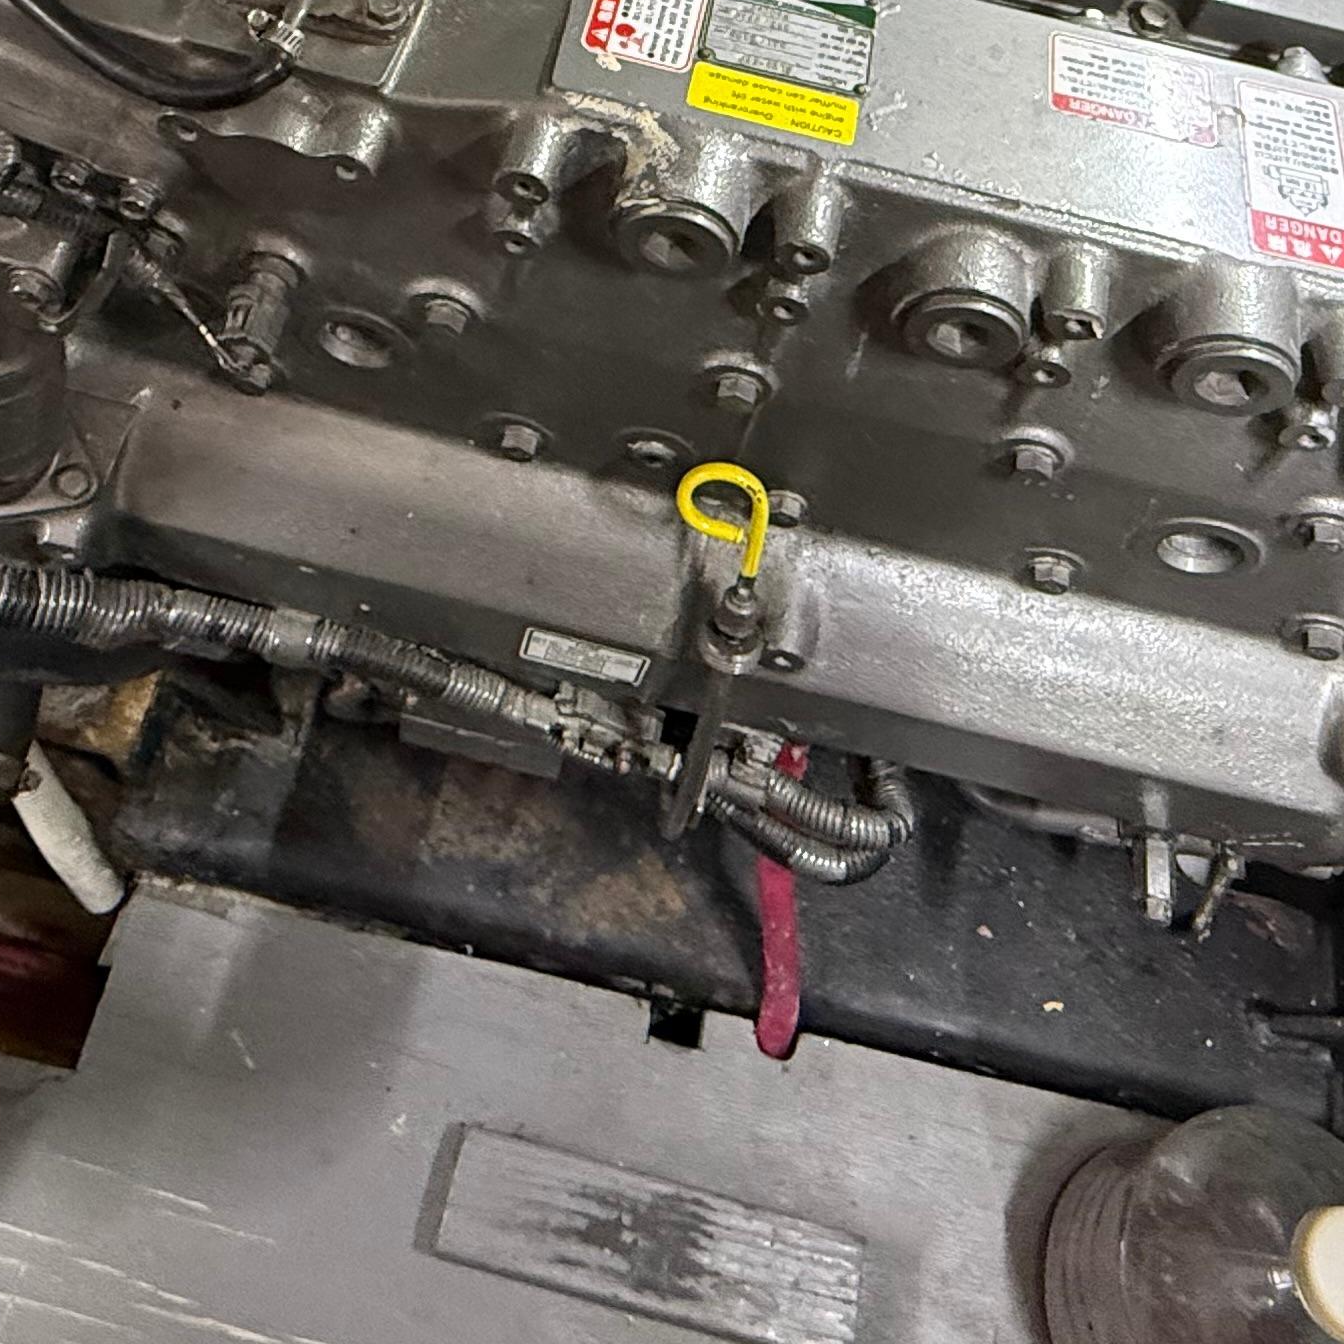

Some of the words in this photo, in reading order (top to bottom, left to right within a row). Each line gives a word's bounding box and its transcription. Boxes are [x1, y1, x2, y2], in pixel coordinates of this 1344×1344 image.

[752, 82, 784, 96] cause
[750, 95, 782, 108] water
[785, 91, 807, 102] can
[784, 102, 807, 114] with
[808, 96, 848, 112] muffler
[810, 110, 845, 123] engine
[1067, 98, 1138, 126] DANGER
[1265, 215, 1344, 245] DANGER
